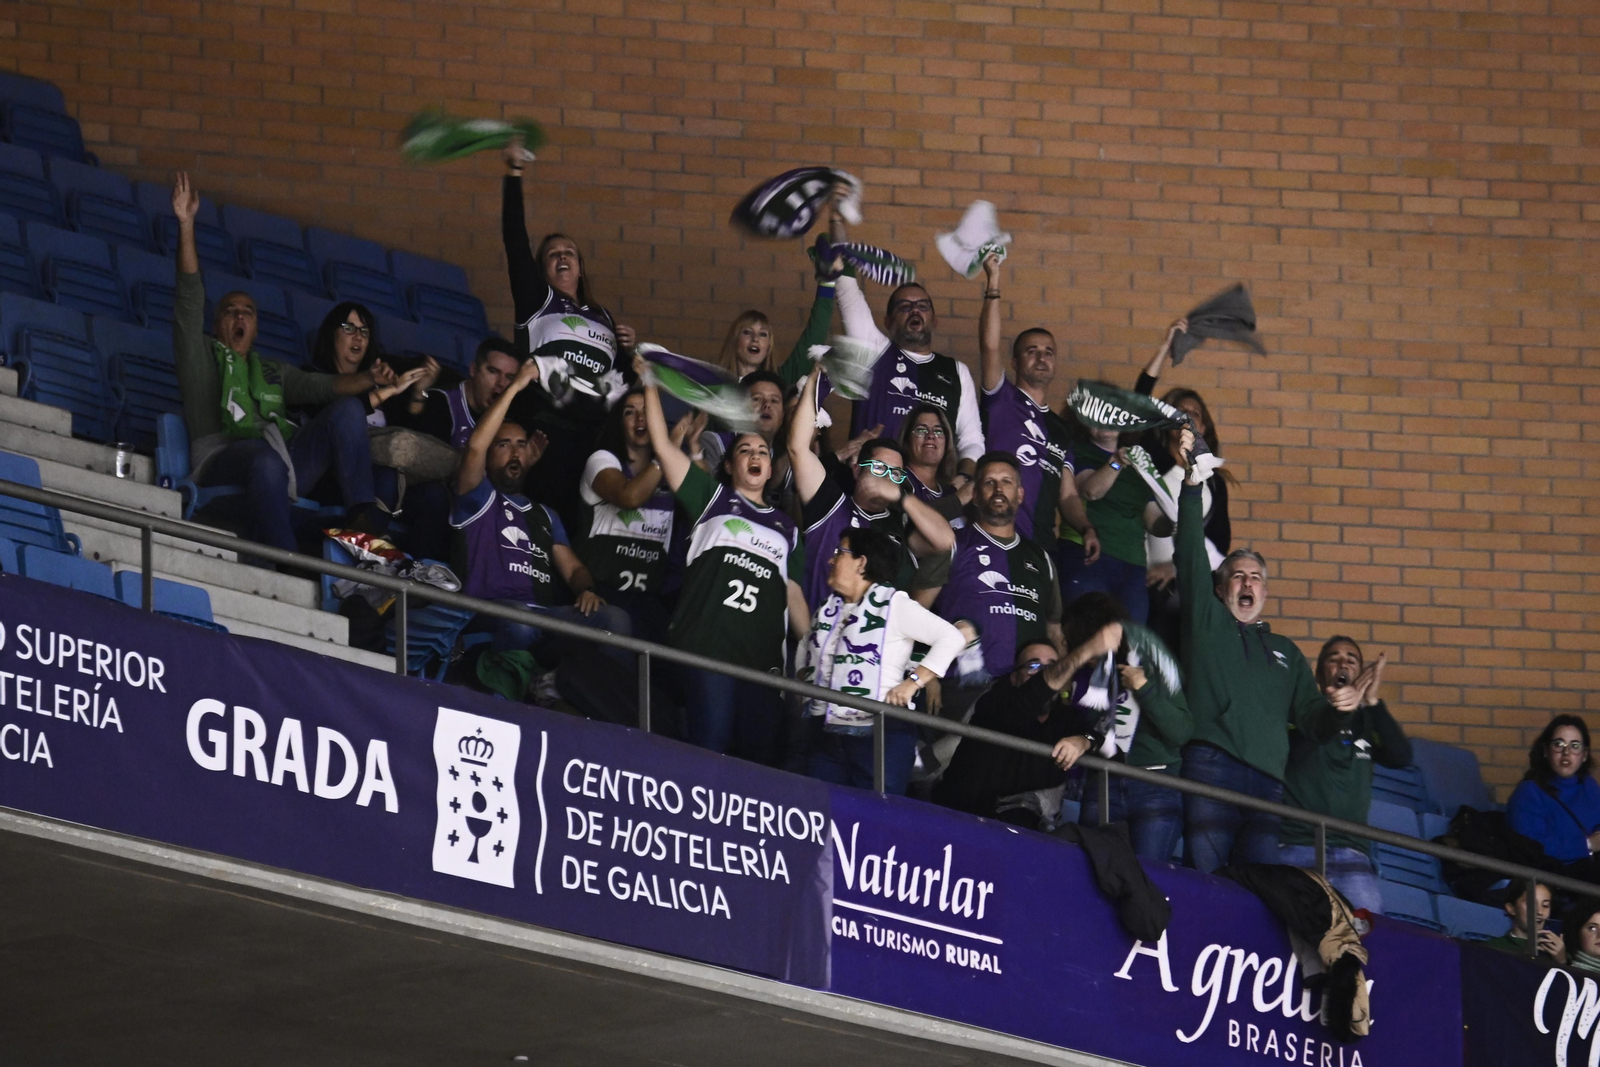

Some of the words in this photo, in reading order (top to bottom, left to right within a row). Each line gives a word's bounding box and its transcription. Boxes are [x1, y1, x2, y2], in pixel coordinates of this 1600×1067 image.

[509, 560, 551, 583] málaga
[616, 542, 659, 563] málaga
[723, 552, 772, 579] málaga
[722, 579, 760, 613] 25
[989, 601, 1037, 622] málaga
[16, 624, 167, 693] SUPERIOR
[186, 698, 399, 813] GRADA
[563, 758, 684, 814] CENTRO
[692, 785, 825, 846] SUPERIOR
[566, 806, 603, 847] DE
[611, 816, 791, 884] HOSTELERÍA
[562, 855, 601, 895] DE
[607, 867, 732, 920] GALICIA
[863, 923, 940, 959] TURISMO
[946, 945, 1002, 974] RURAL
[1228, 1019, 1364, 1067] BRASERIA
